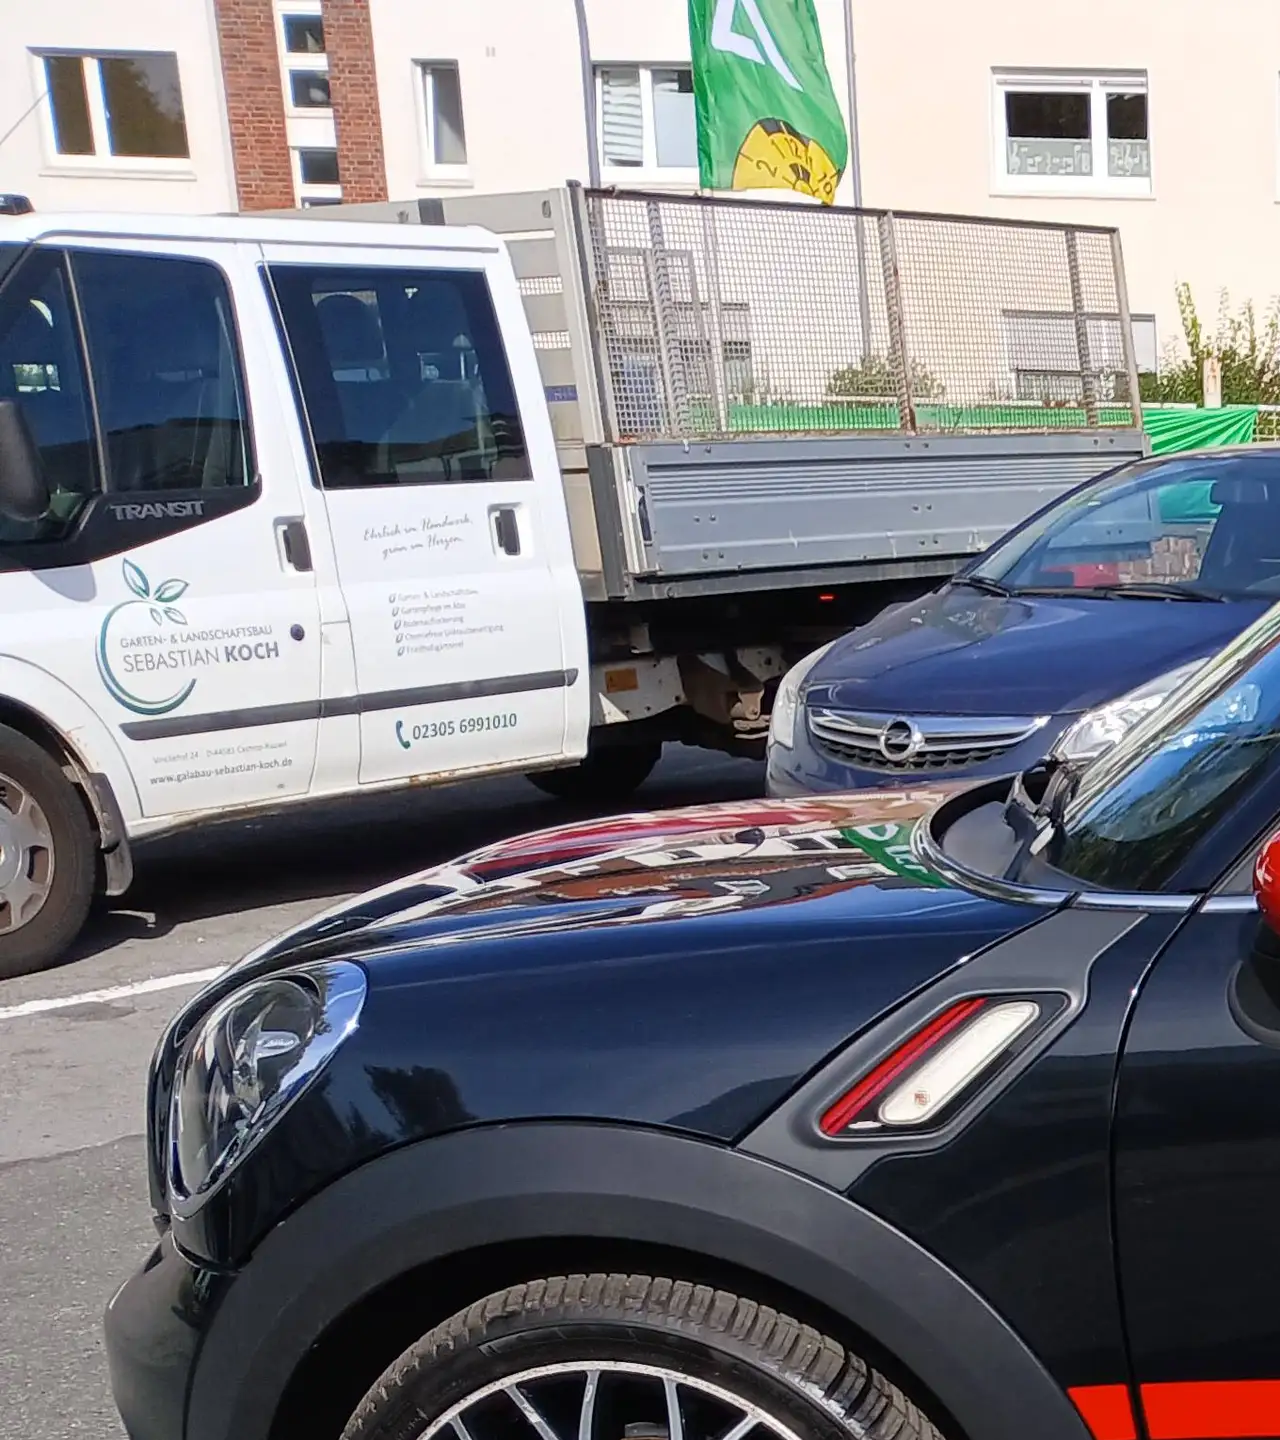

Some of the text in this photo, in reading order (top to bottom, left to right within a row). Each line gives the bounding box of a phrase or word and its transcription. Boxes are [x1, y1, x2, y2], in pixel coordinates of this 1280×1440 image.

[110, 500, 204, 521] TRANSIT
[120, 625, 273, 649] GARTEN- & LANDSCHAFTSBAU
[123, 641, 279, 673] SEBASTIAN KOCH
[412, 713, 518, 740] 02305 6991010
[150, 757, 293, 785] www.galabau-sebastian-koch.de
